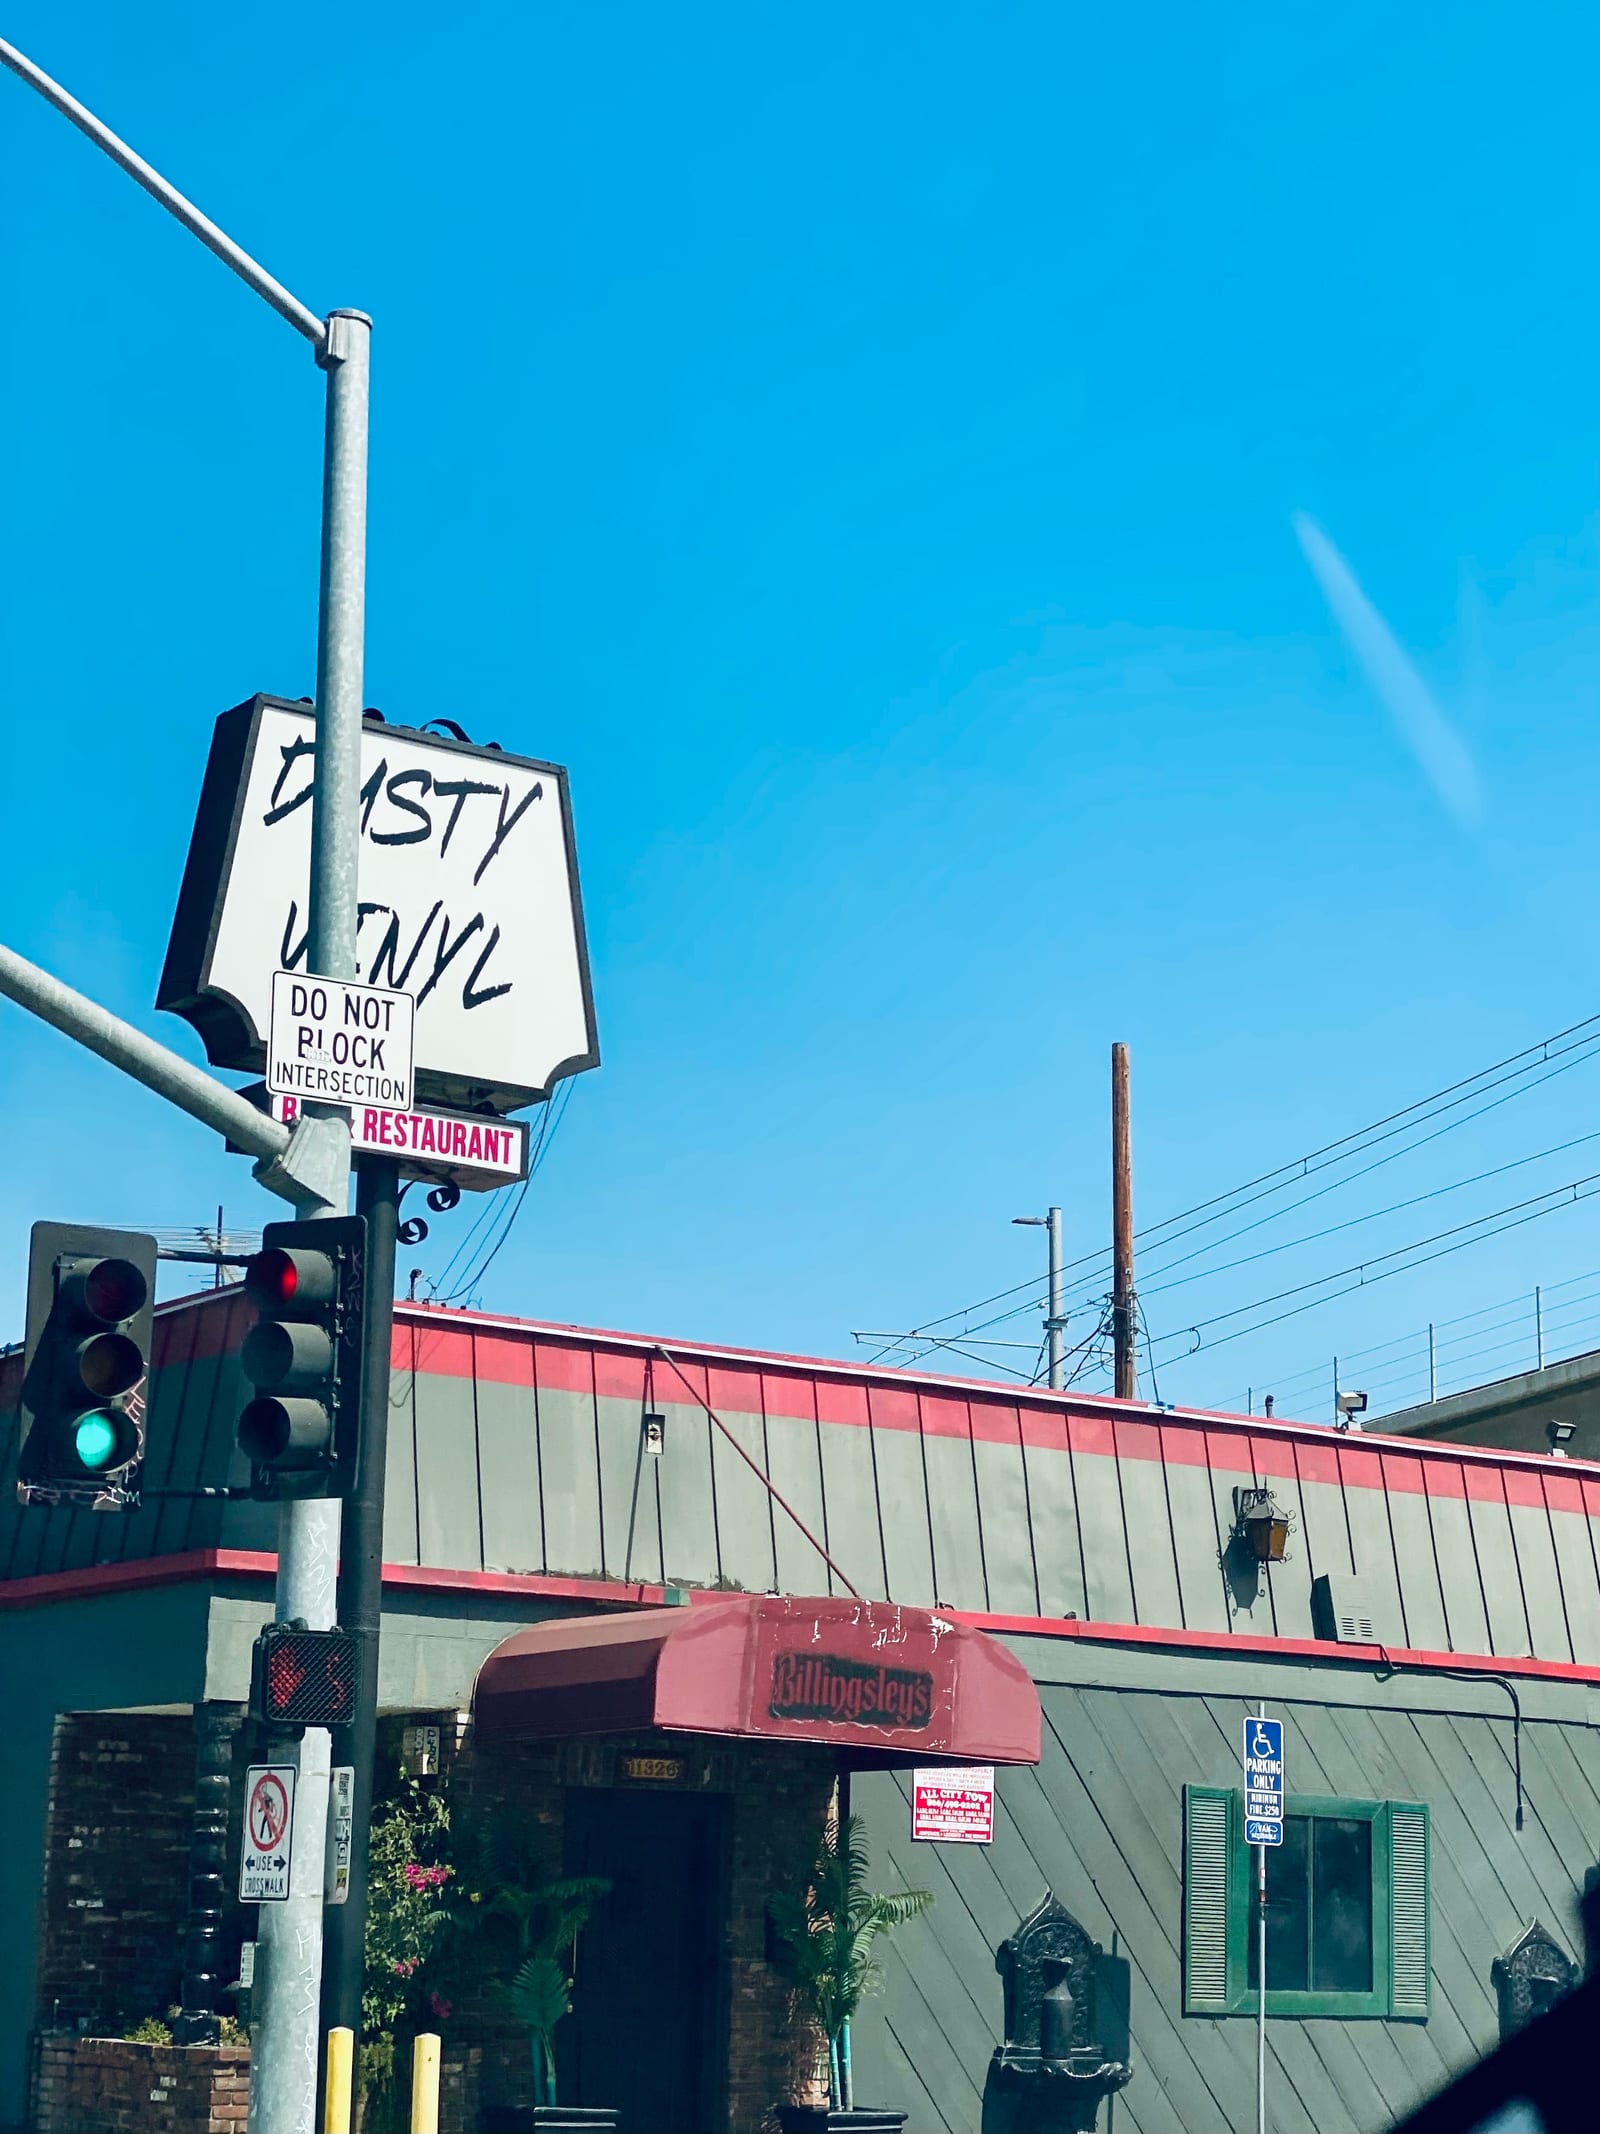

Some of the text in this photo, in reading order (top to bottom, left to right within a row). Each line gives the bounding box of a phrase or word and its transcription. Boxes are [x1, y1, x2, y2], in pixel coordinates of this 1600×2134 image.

[291, 984, 396, 1032] DO NOT
[276, 1060, 405, 1102] INTERSECTION
[362, 1108, 514, 1165] RESTAURANT
[774, 1652, 929, 1724] Billingsley's
[1247, 1757, 1281, 1775] PARKING
[1253, 1774, 1275, 1790] ONLY
[920, 1789, 988, 1804] ALL CITY TOW
[255, 1856, 272, 1871] USE
[244, 1877, 284, 1894] CROSSWALK
